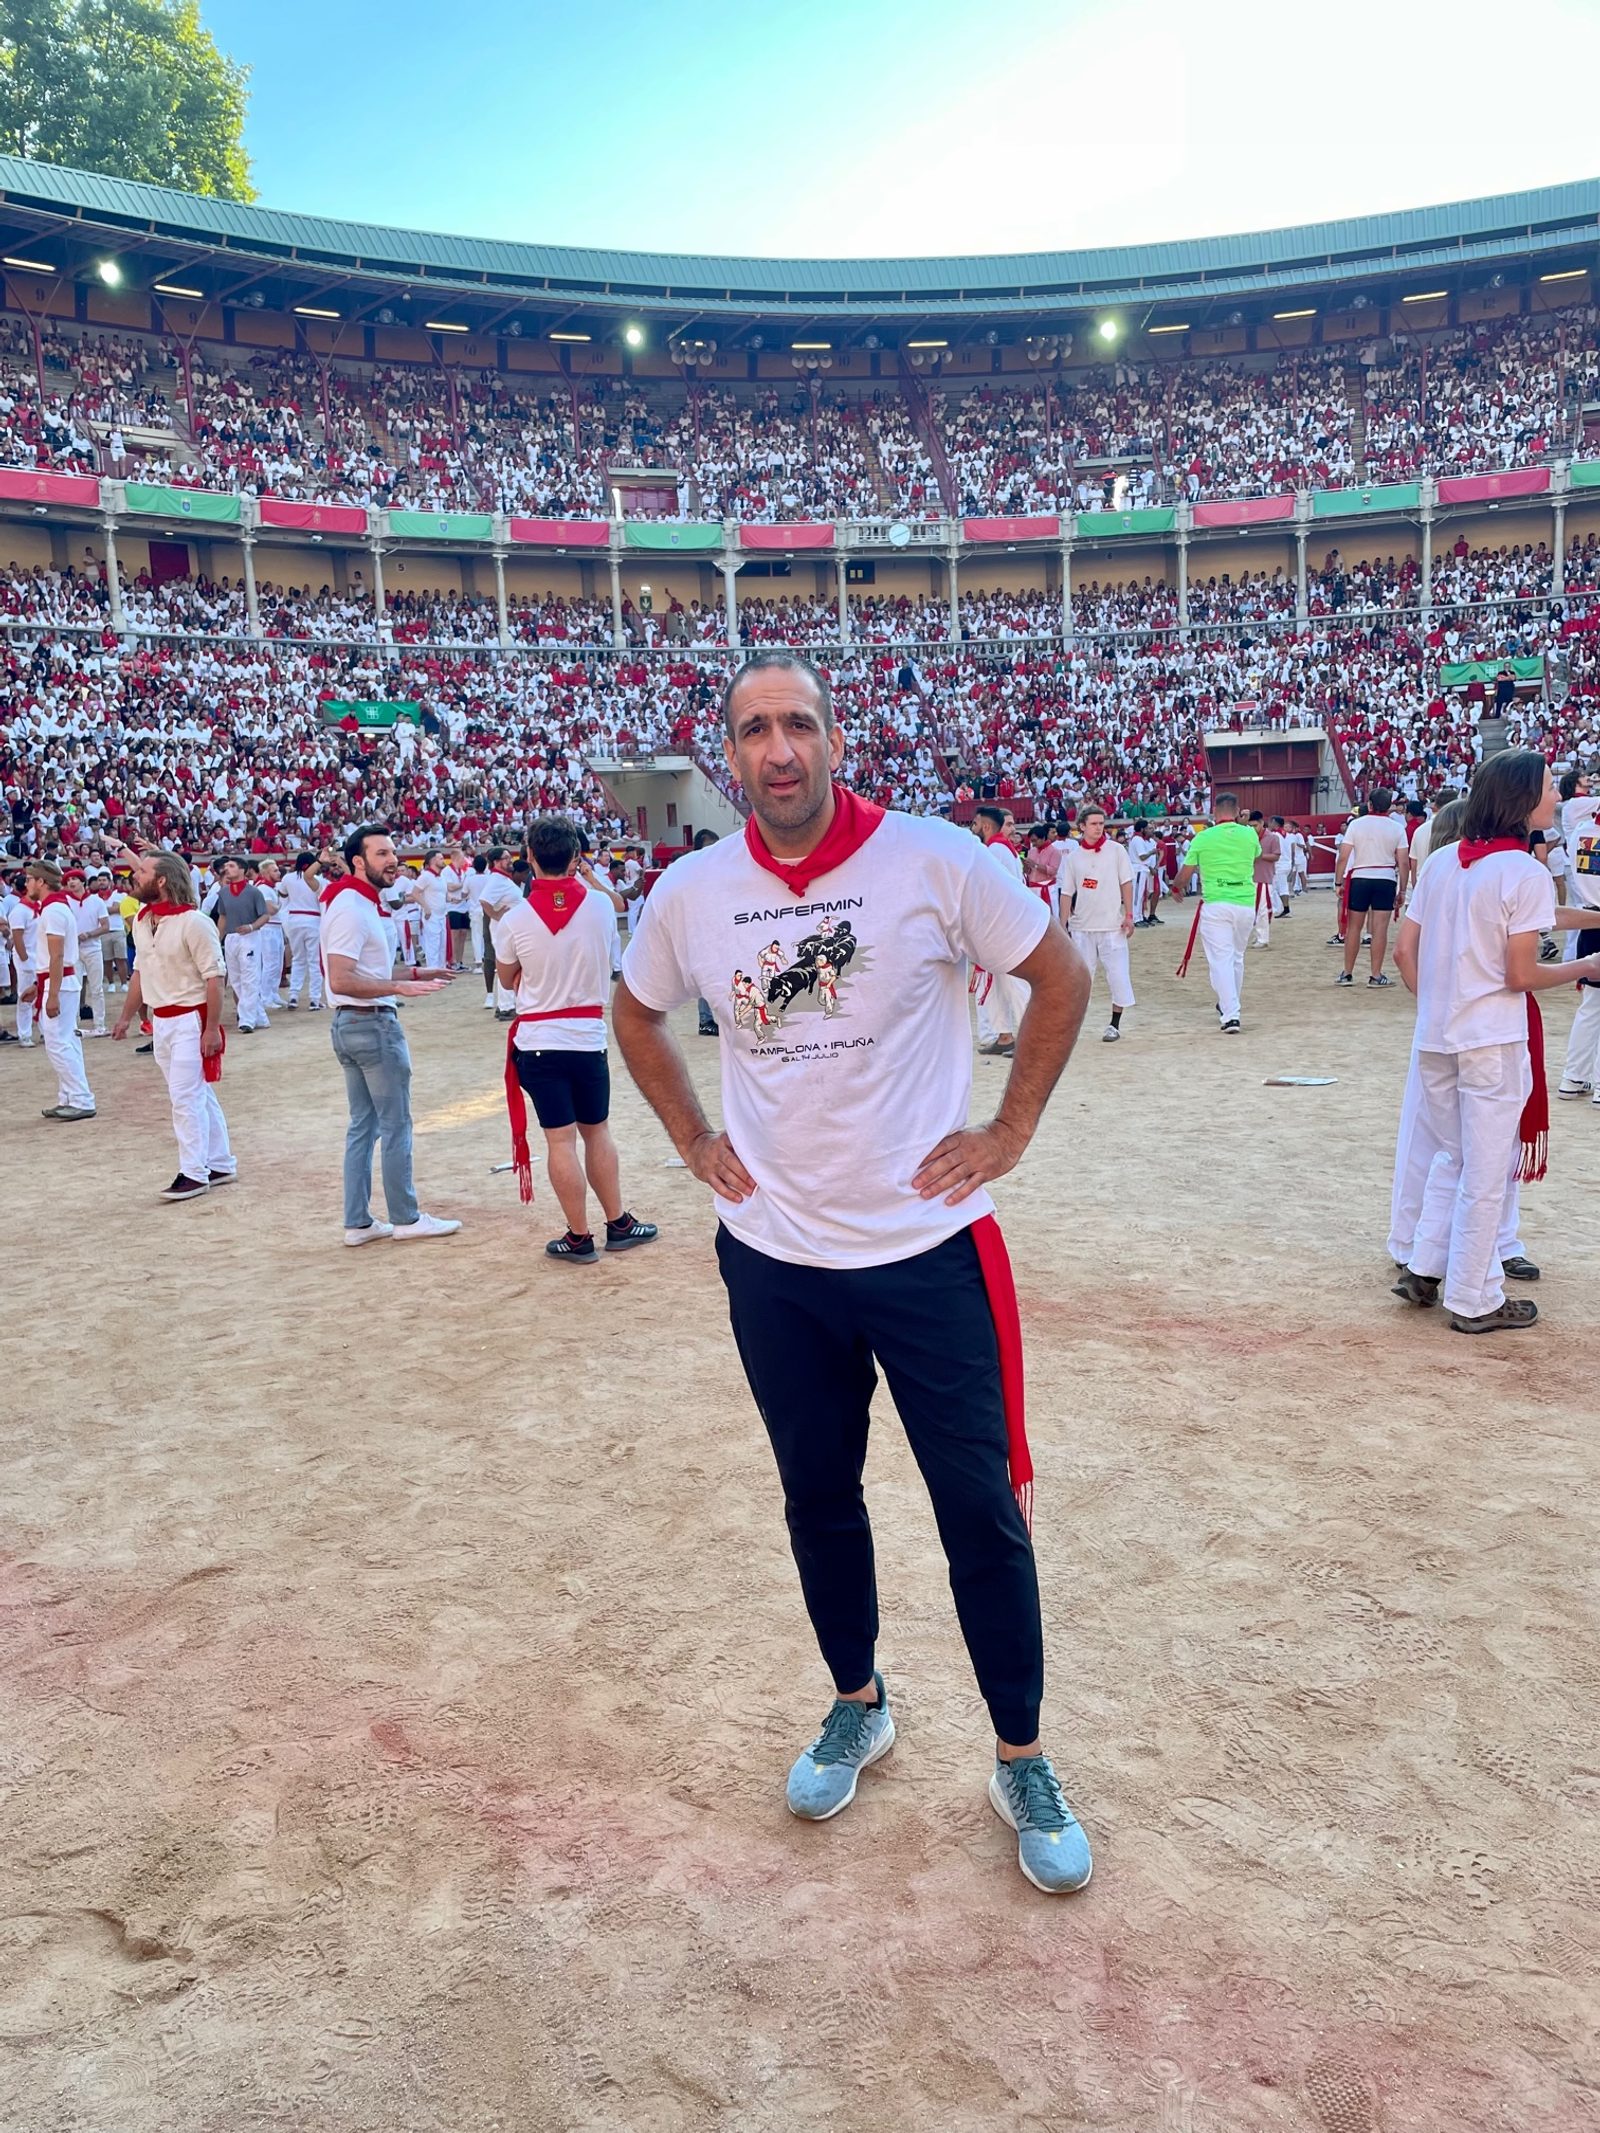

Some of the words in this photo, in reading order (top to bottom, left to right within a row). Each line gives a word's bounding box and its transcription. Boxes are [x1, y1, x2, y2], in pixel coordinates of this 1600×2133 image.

[398, 563, 405, 572] 5
[734, 897, 863, 925] SANFERMIN
[750, 1043, 821, 1056] PAMPLONA
[830, 1037, 875, 1050] IRUÑA
[811, 1052, 839, 1060] JULIO
